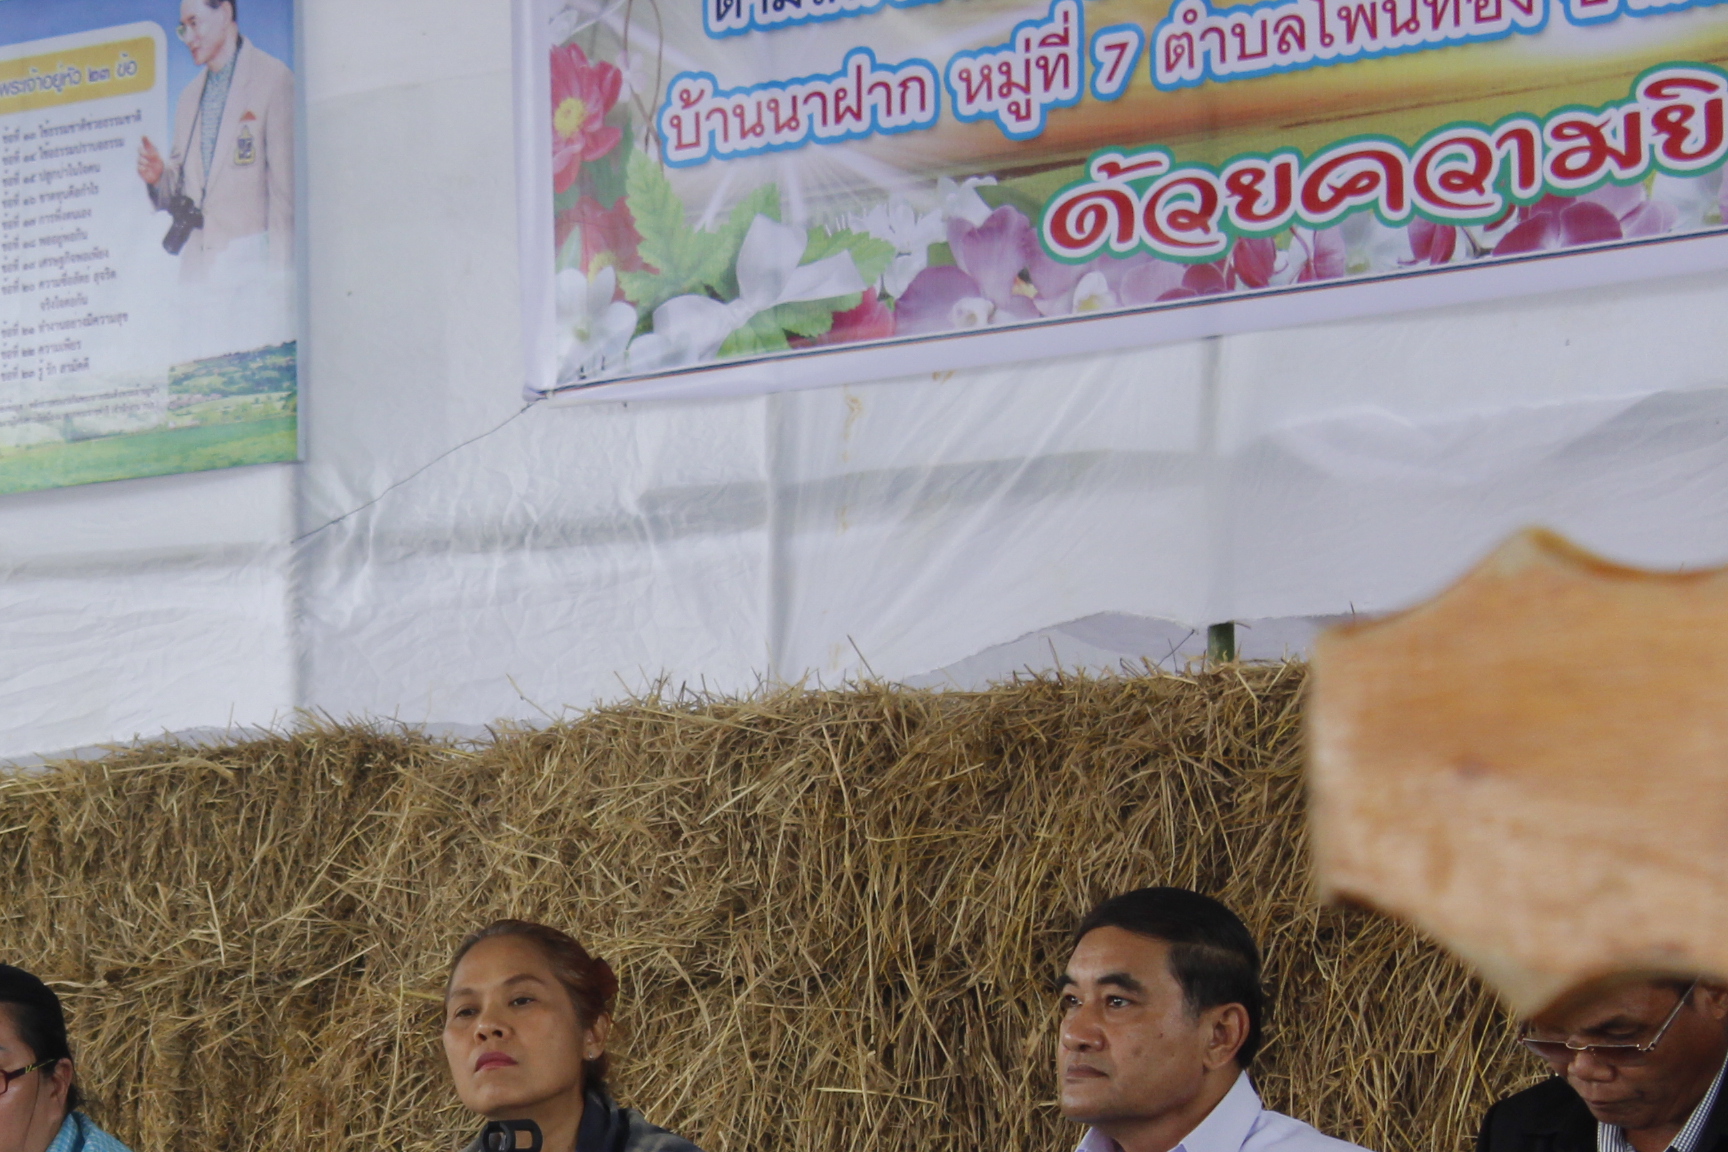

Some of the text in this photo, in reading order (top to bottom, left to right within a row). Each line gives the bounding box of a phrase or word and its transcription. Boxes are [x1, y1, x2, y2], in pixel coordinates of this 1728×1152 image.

[117, 52, 139, 79] ข้อ
[669, 63, 926, 152] บ้านนาฝาก
[958, 11, 1070, 123] หมู่ที่
[1103, 41, 1130, 84] 7
